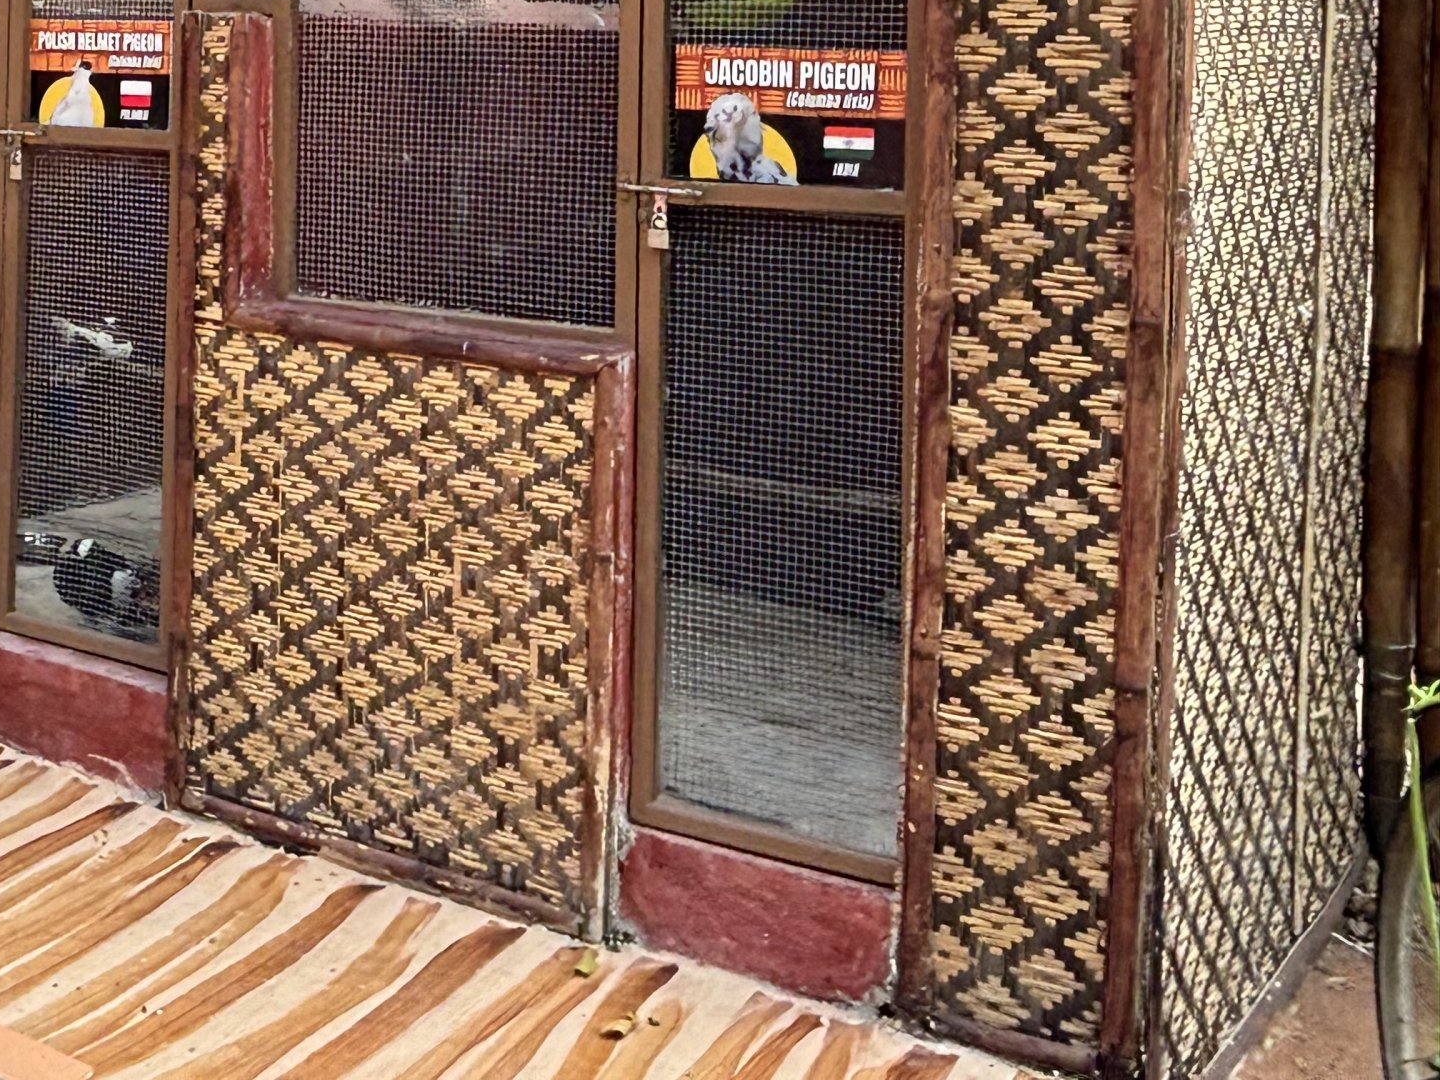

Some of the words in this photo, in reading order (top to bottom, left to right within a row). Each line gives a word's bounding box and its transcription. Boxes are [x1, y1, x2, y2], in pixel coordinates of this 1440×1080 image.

[38, 31, 76, 51] POLISH
[78, 32, 121, 51] HELMET
[123, 32, 163, 52] PIGEON
[704, 58, 793, 88] JACOBIN
[799, 61, 876, 91] PIGEON
